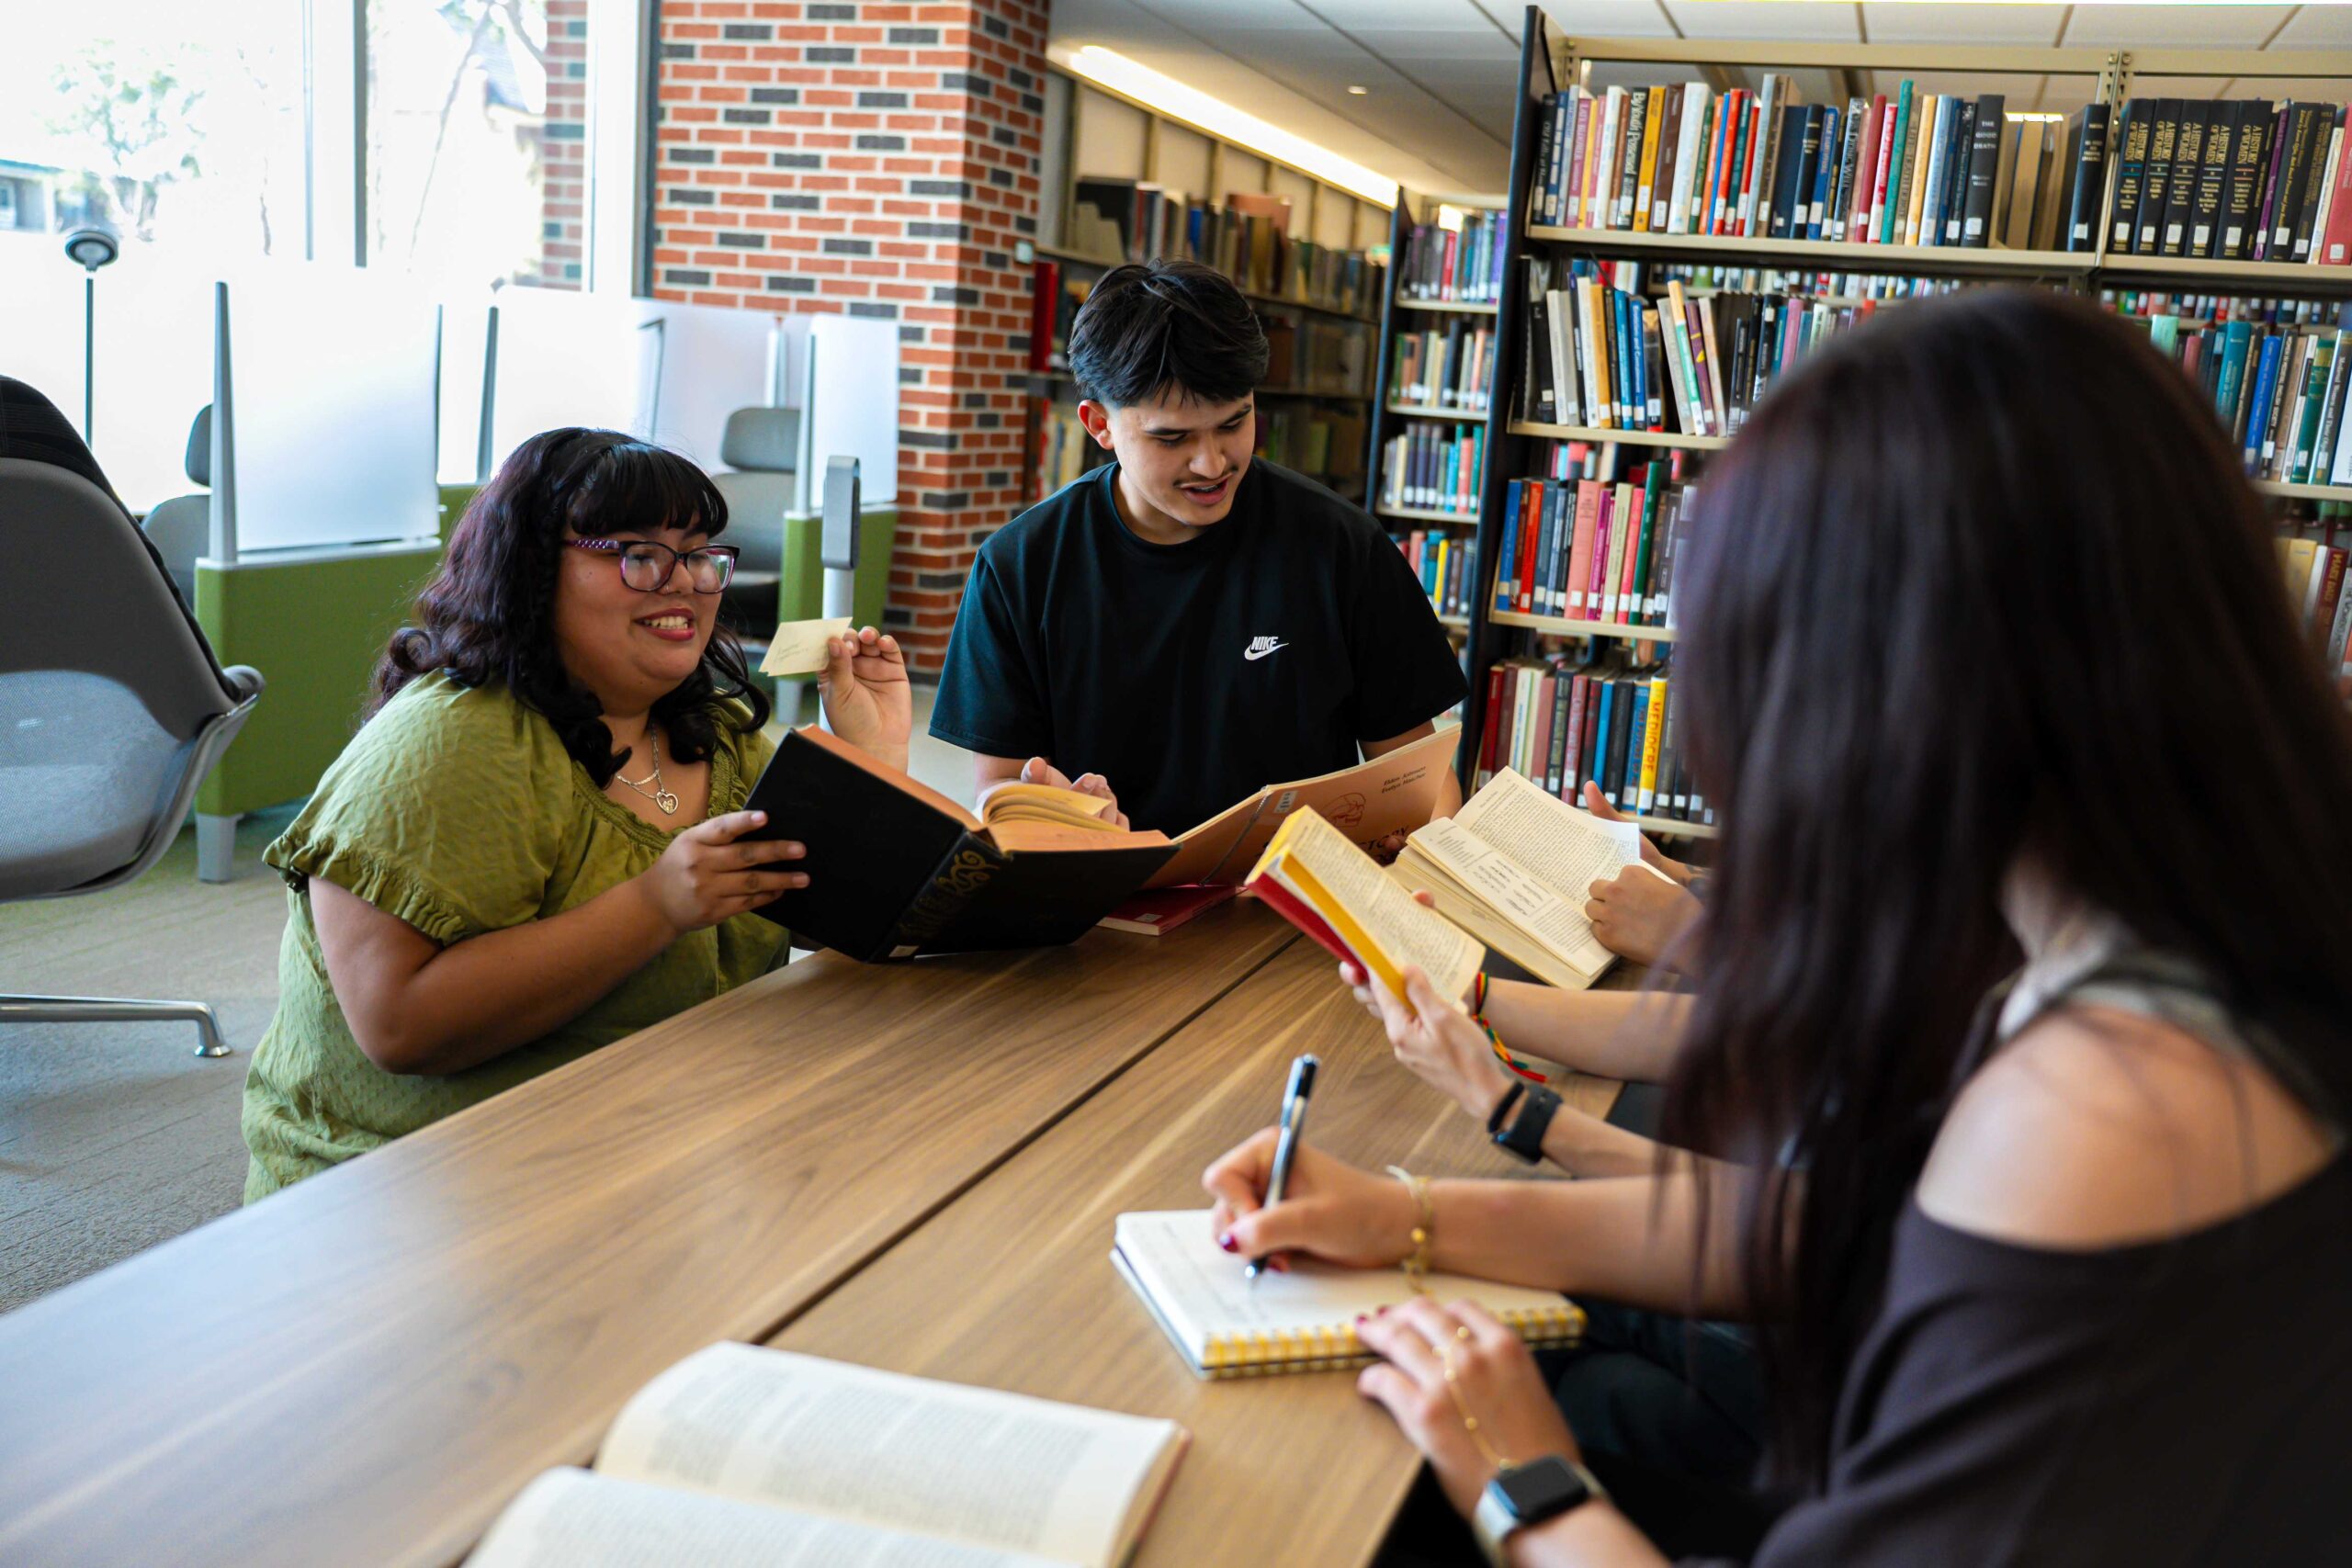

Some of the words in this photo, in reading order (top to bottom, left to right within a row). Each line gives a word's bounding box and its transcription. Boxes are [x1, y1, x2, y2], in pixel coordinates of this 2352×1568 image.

[1632, 106, 1644, 131] Youth
[2124, 130, 2138, 162] WOMEN
[2134, 129, 2148, 162] HISTORY
[2151, 130, 2165, 161] WOMEN
[2161, 129, 2176, 161] HISTORY
[2177, 131, 2191, 162] WOMEN
[2187, 130, 2202, 163] HISTORY
[2205, 134, 2219, 164] WOMEN
[2215, 132, 2230, 164] HISTORY
[2237, 134, 2251, 164] WOMEN
[2247, 132, 2262, 164] HISTORY
[1250, 636, 1279, 650] NIKE
[1643, 701, 1661, 772] MEDIOCRE
